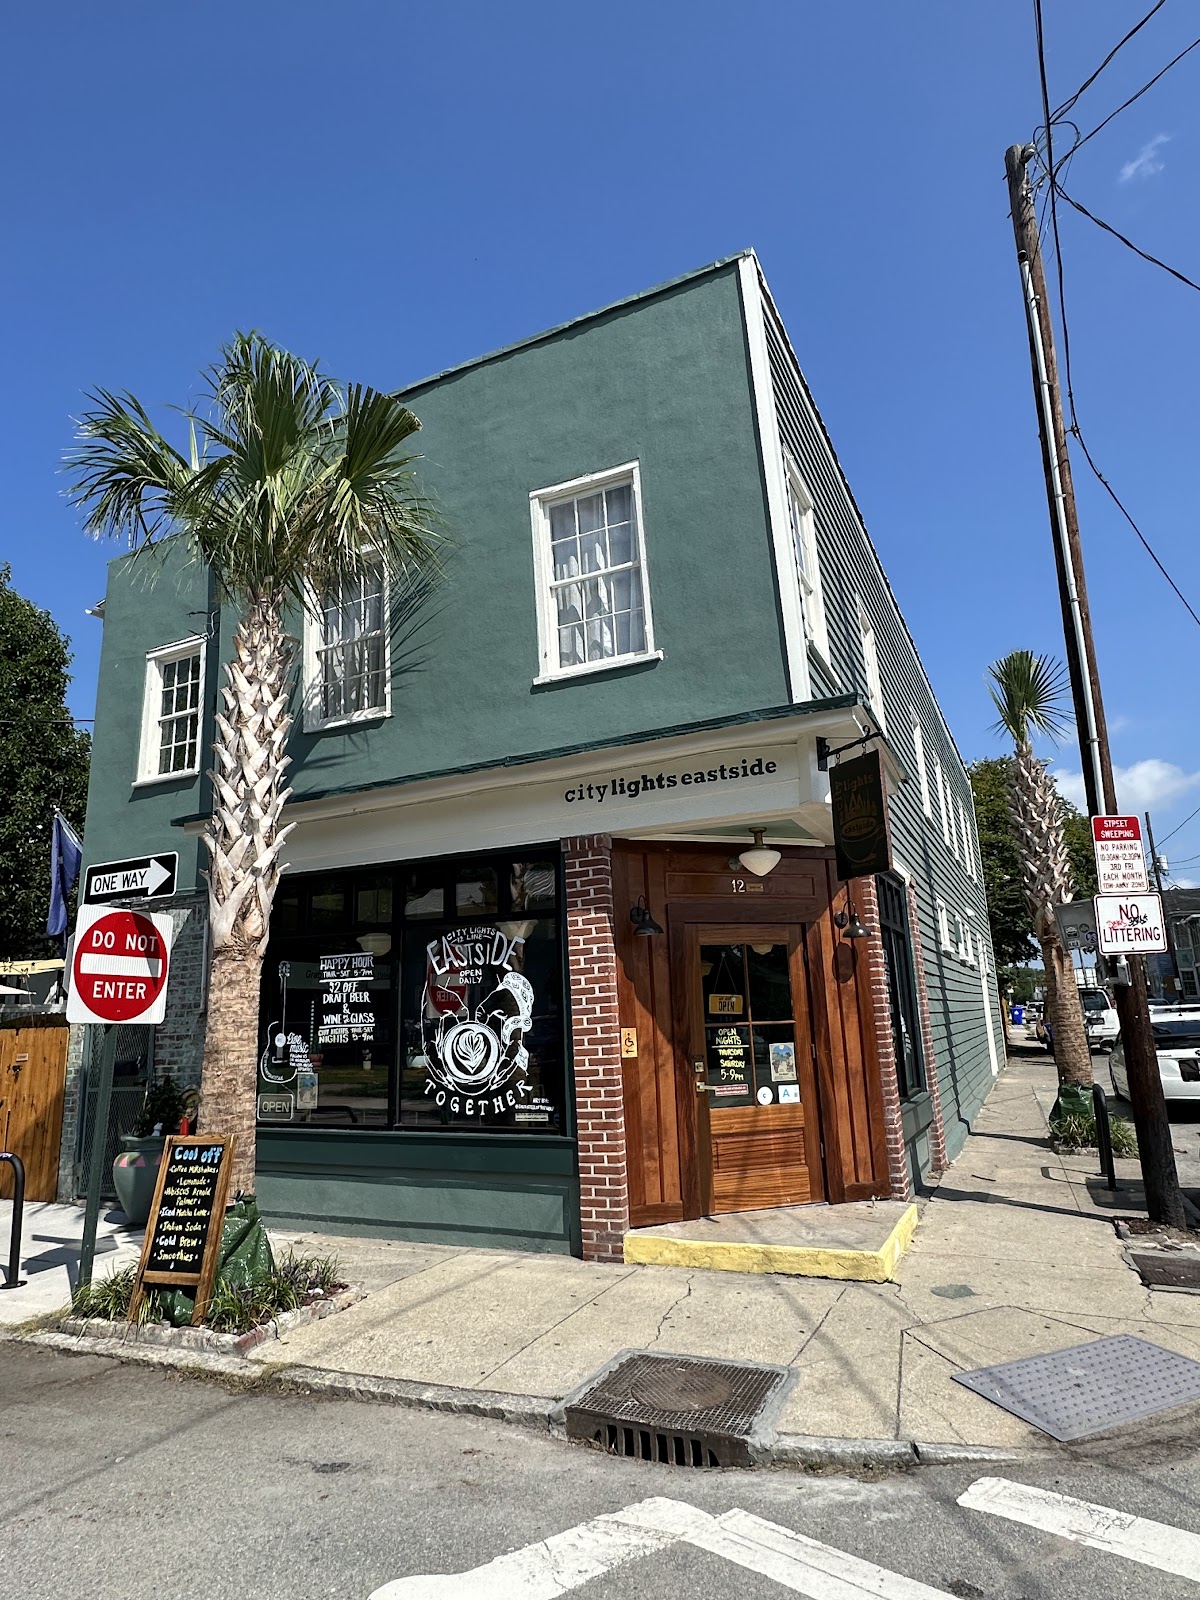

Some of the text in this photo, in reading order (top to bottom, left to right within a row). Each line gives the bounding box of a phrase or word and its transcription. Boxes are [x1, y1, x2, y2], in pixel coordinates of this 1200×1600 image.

[844, 820, 875, 835] eastside
[1103, 819, 1128, 828] STREET
[1100, 829, 1134, 838] SWEEPING
[1100, 843, 1138, 851] NO PARKING
[1110, 863, 1121, 871] 3RD
[94, 870, 148, 893] ONE WAY
[1122, 871, 1143, 880] MONTH
[731, 879, 746, 893] 12
[1119, 903, 1139, 921] NO
[446, 926, 497, 941] CITY LIGHTS
[1103, 926, 1161, 943] LITTERING
[91, 930, 157, 952] DO NOT
[426, 931, 526, 975] EASTSIDE
[320, 955, 375, 971] HAPPY HOUR
[460, 968, 483, 977] OPEN
[459, 976, 483, 985] DAILY
[92, 980, 147, 999] ENTER
[342, 981, 359, 993] OFF
[322, 991, 371, 1005] DRAFT BEER
[343, 1003, 351, 1015] &
[718, 1000, 735, 1012] OPEN
[322, 1013, 342, 1025] WINE
[350, 1012, 375, 1024] GLASS
[718, 1027, 737, 1036] OPEN
[318, 1034, 349, 1043] NIGHTS
[715, 1035, 742, 1045] NIGHTS
[720, 1059, 745, 1069] SATURDAY
[424, 1078, 533, 1115] TOGETHER
[262, 1101, 290, 1113] OPEN
[174, 1146, 223, 1164] Cool off
[184, 1221, 202, 1232] Soda
[159, 1234, 198, 1247] Cold Brew
[157, 1249, 194, 1263] Smoothies
